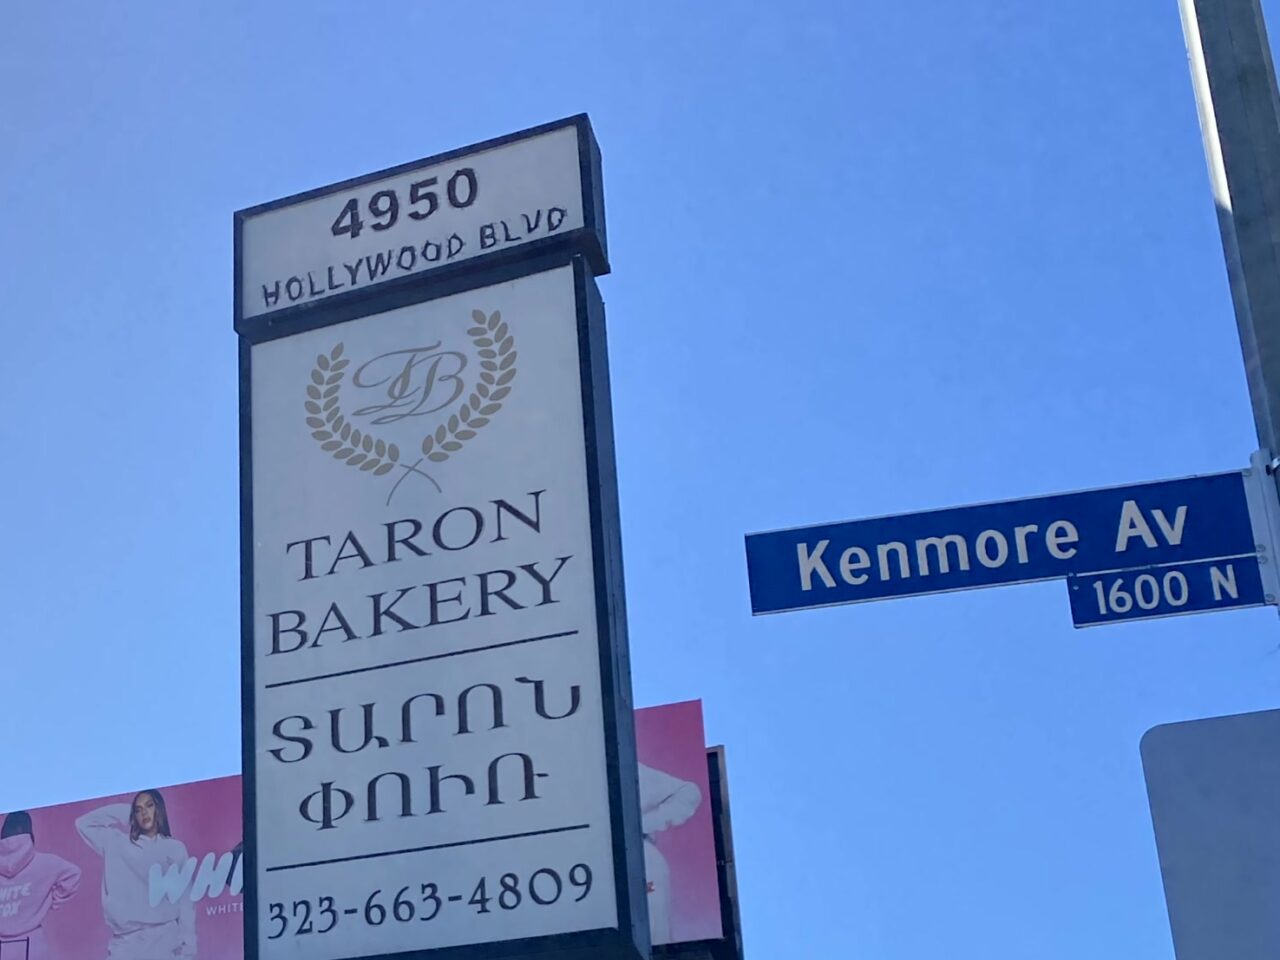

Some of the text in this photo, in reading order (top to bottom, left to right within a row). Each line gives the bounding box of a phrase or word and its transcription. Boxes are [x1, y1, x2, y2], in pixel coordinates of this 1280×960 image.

[331, 167, 478, 240] 4950
[261, 207, 568, 307] HOLLYWOOD BLVD
[286, 489, 547, 582] TARON
[796, 500, 1188, 592] Kenmore Av
[265, 555, 574, 657] BAKERY
[1093, 564, 1239, 615] 1600 N
[267, 863, 593, 940] 323-663-4809
